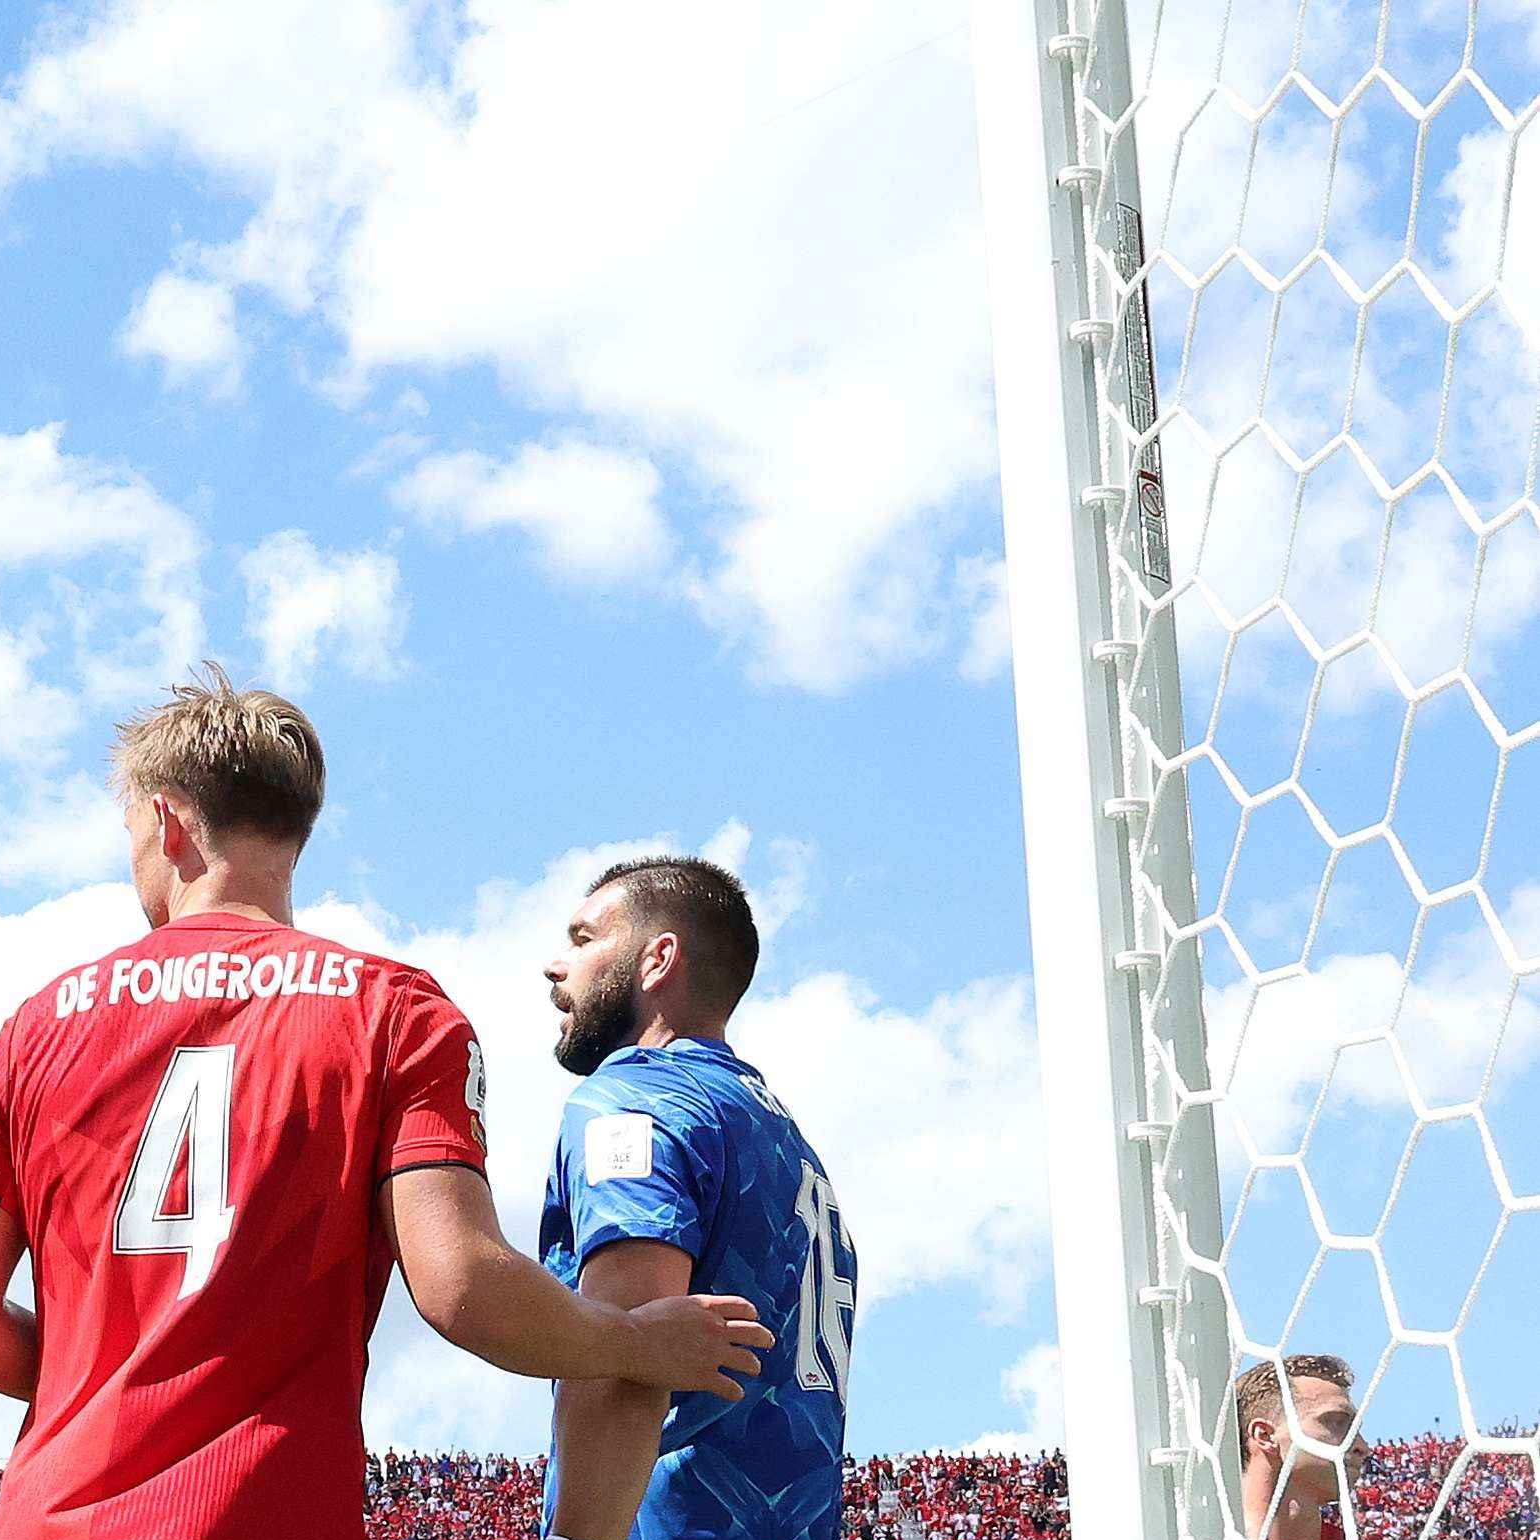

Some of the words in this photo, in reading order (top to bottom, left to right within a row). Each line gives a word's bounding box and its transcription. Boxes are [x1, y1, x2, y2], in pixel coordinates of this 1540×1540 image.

[56, 964, 99, 1019] DE
[108, 950, 364, 1006] FOUGEROLLES
[112, 1043, 236, 1300] 4
